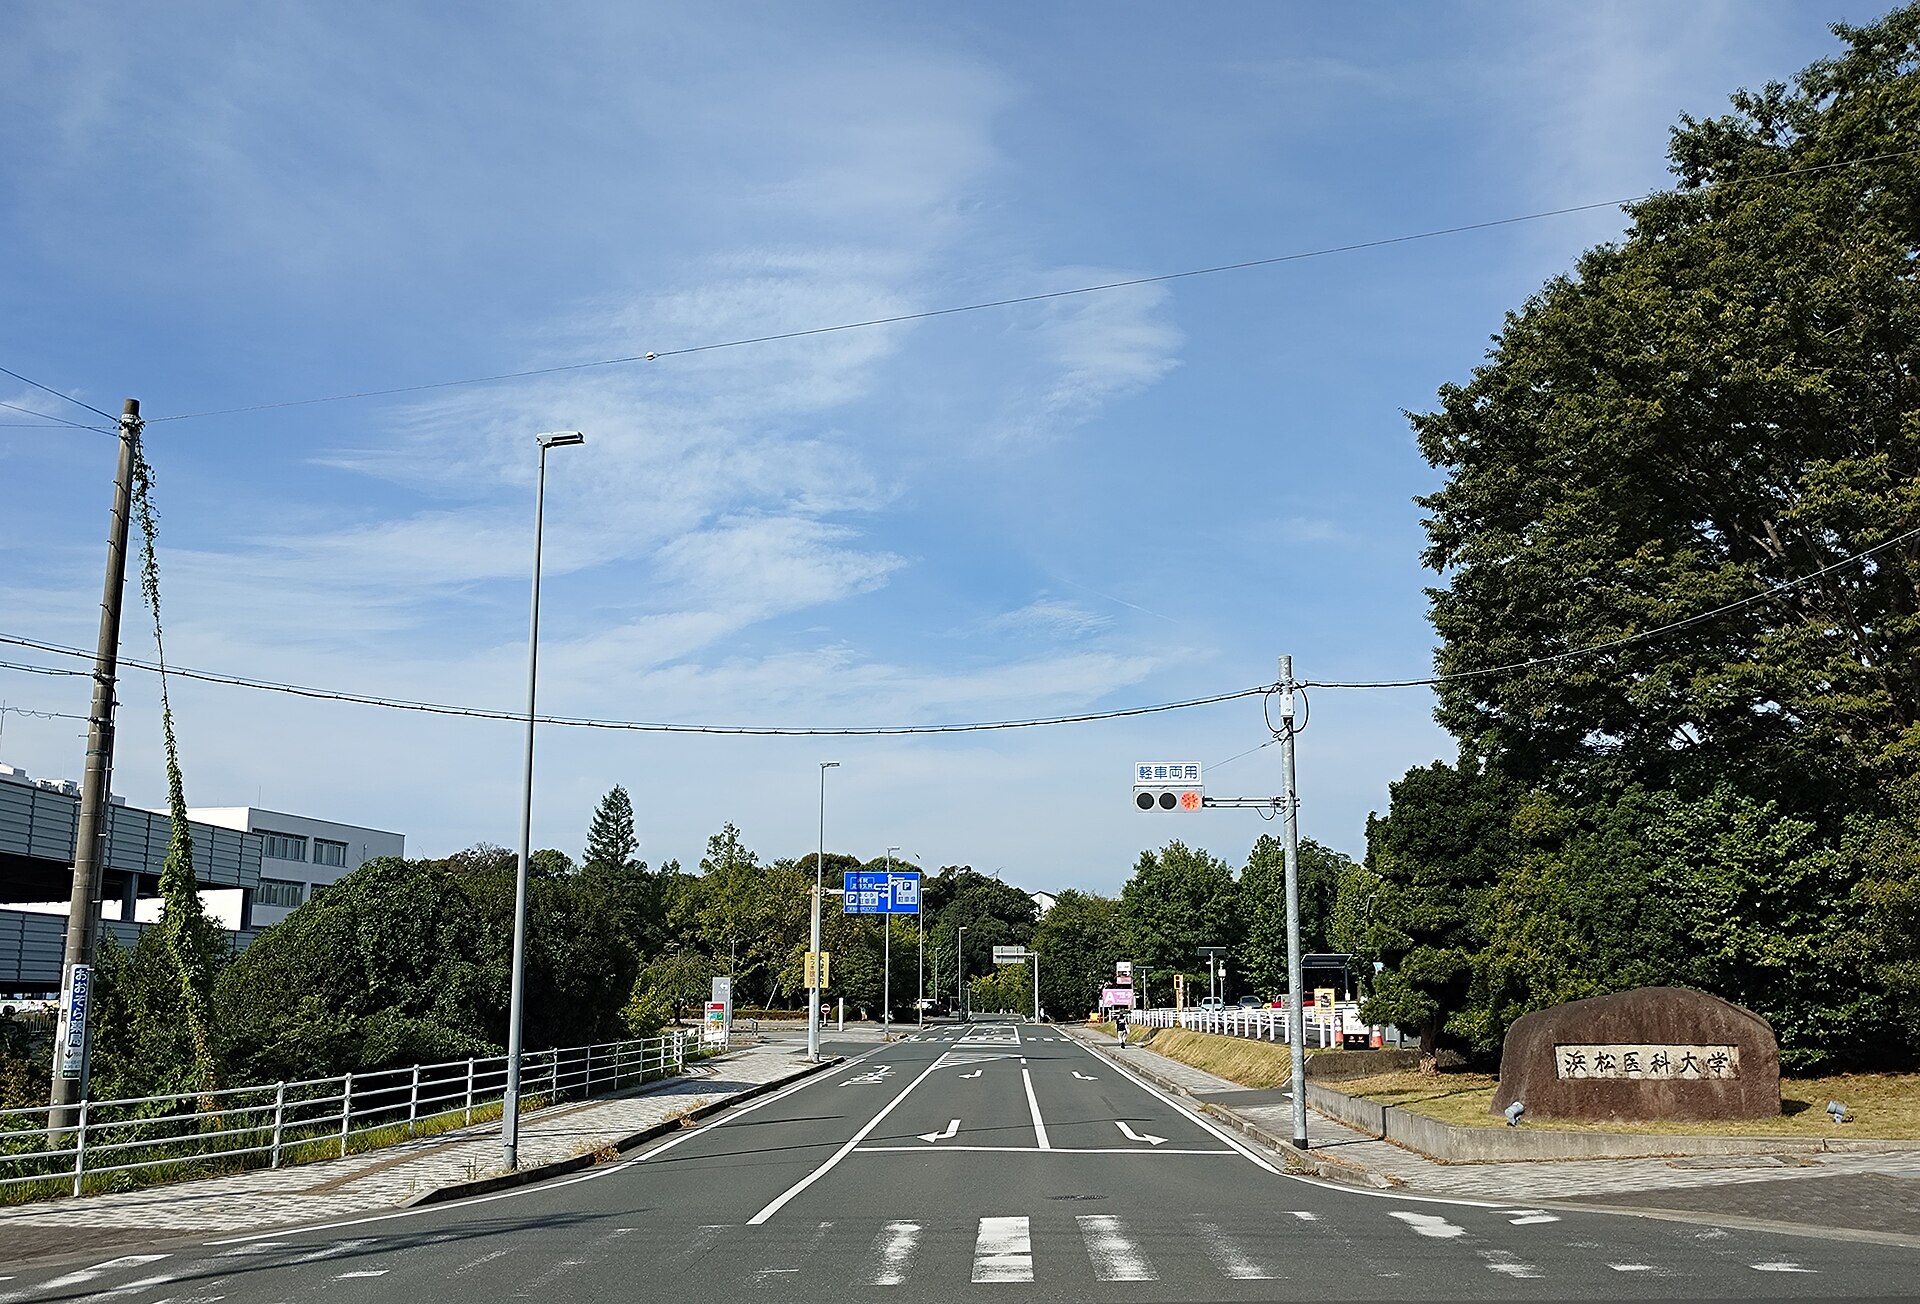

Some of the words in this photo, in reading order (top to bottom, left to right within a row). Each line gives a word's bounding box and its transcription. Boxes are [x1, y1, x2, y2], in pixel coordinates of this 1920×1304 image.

[1139, 765, 1198, 779] 軽車両用
[1564, 1050, 1729, 1075] 浜松医科大学
